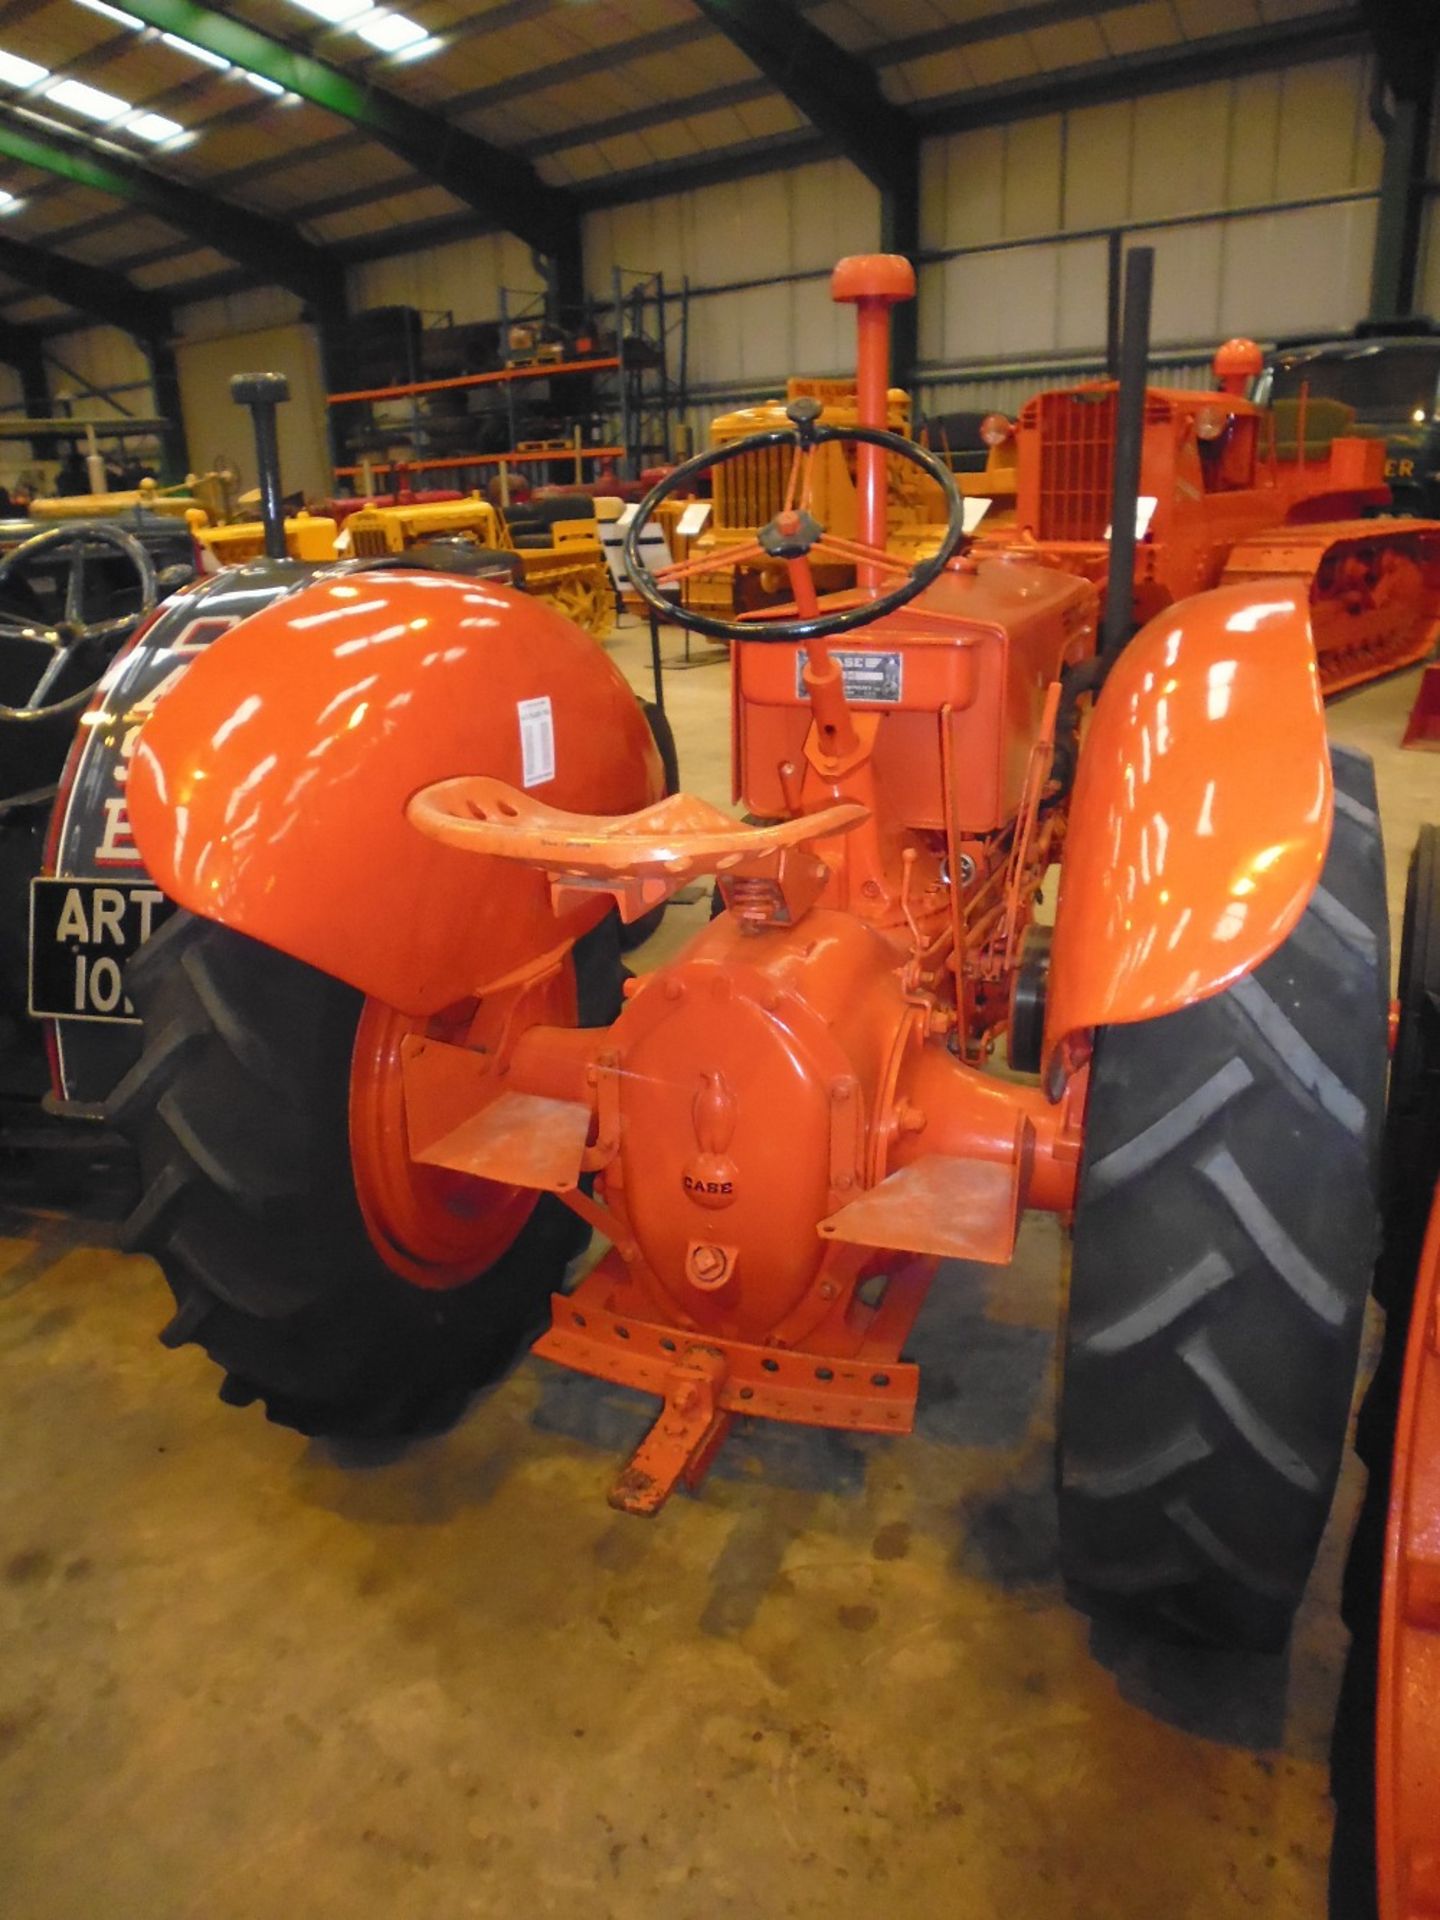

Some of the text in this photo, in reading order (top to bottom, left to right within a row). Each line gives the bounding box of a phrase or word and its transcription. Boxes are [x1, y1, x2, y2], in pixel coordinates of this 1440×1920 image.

[1384, 458, 1415, 478] ER
[56, 888, 164, 945] ART
[74, 955, 134, 1014] 10
[683, 1176, 733, 1194] CASE
